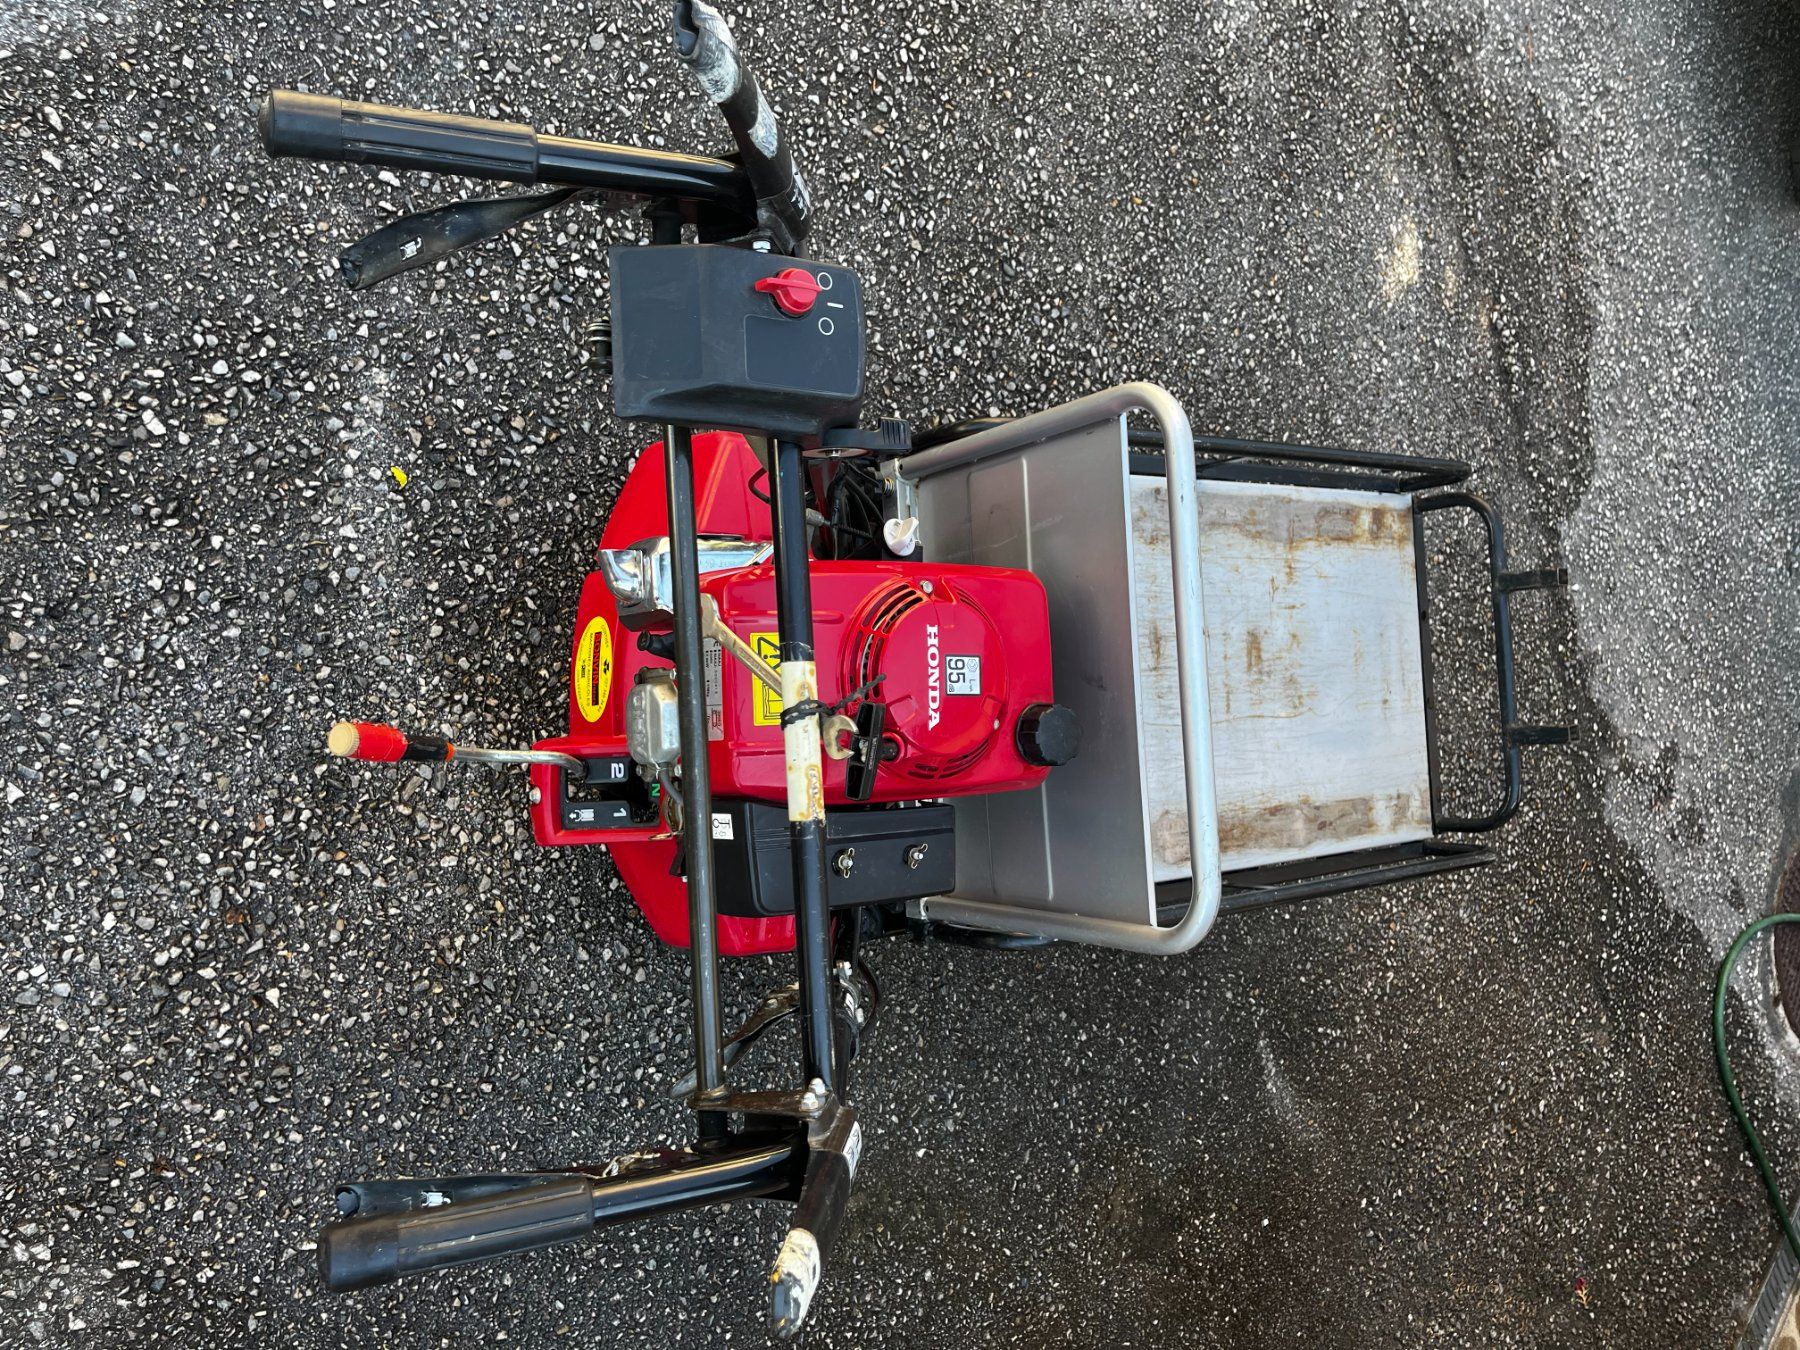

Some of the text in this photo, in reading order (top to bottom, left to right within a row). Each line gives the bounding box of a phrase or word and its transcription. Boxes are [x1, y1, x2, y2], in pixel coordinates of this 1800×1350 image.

[926, 624, 940, 731] HONDA
[947, 658, 965, 683] 95
[610, 763, 625, 779] 2
[613, 808, 627, 817] 1
